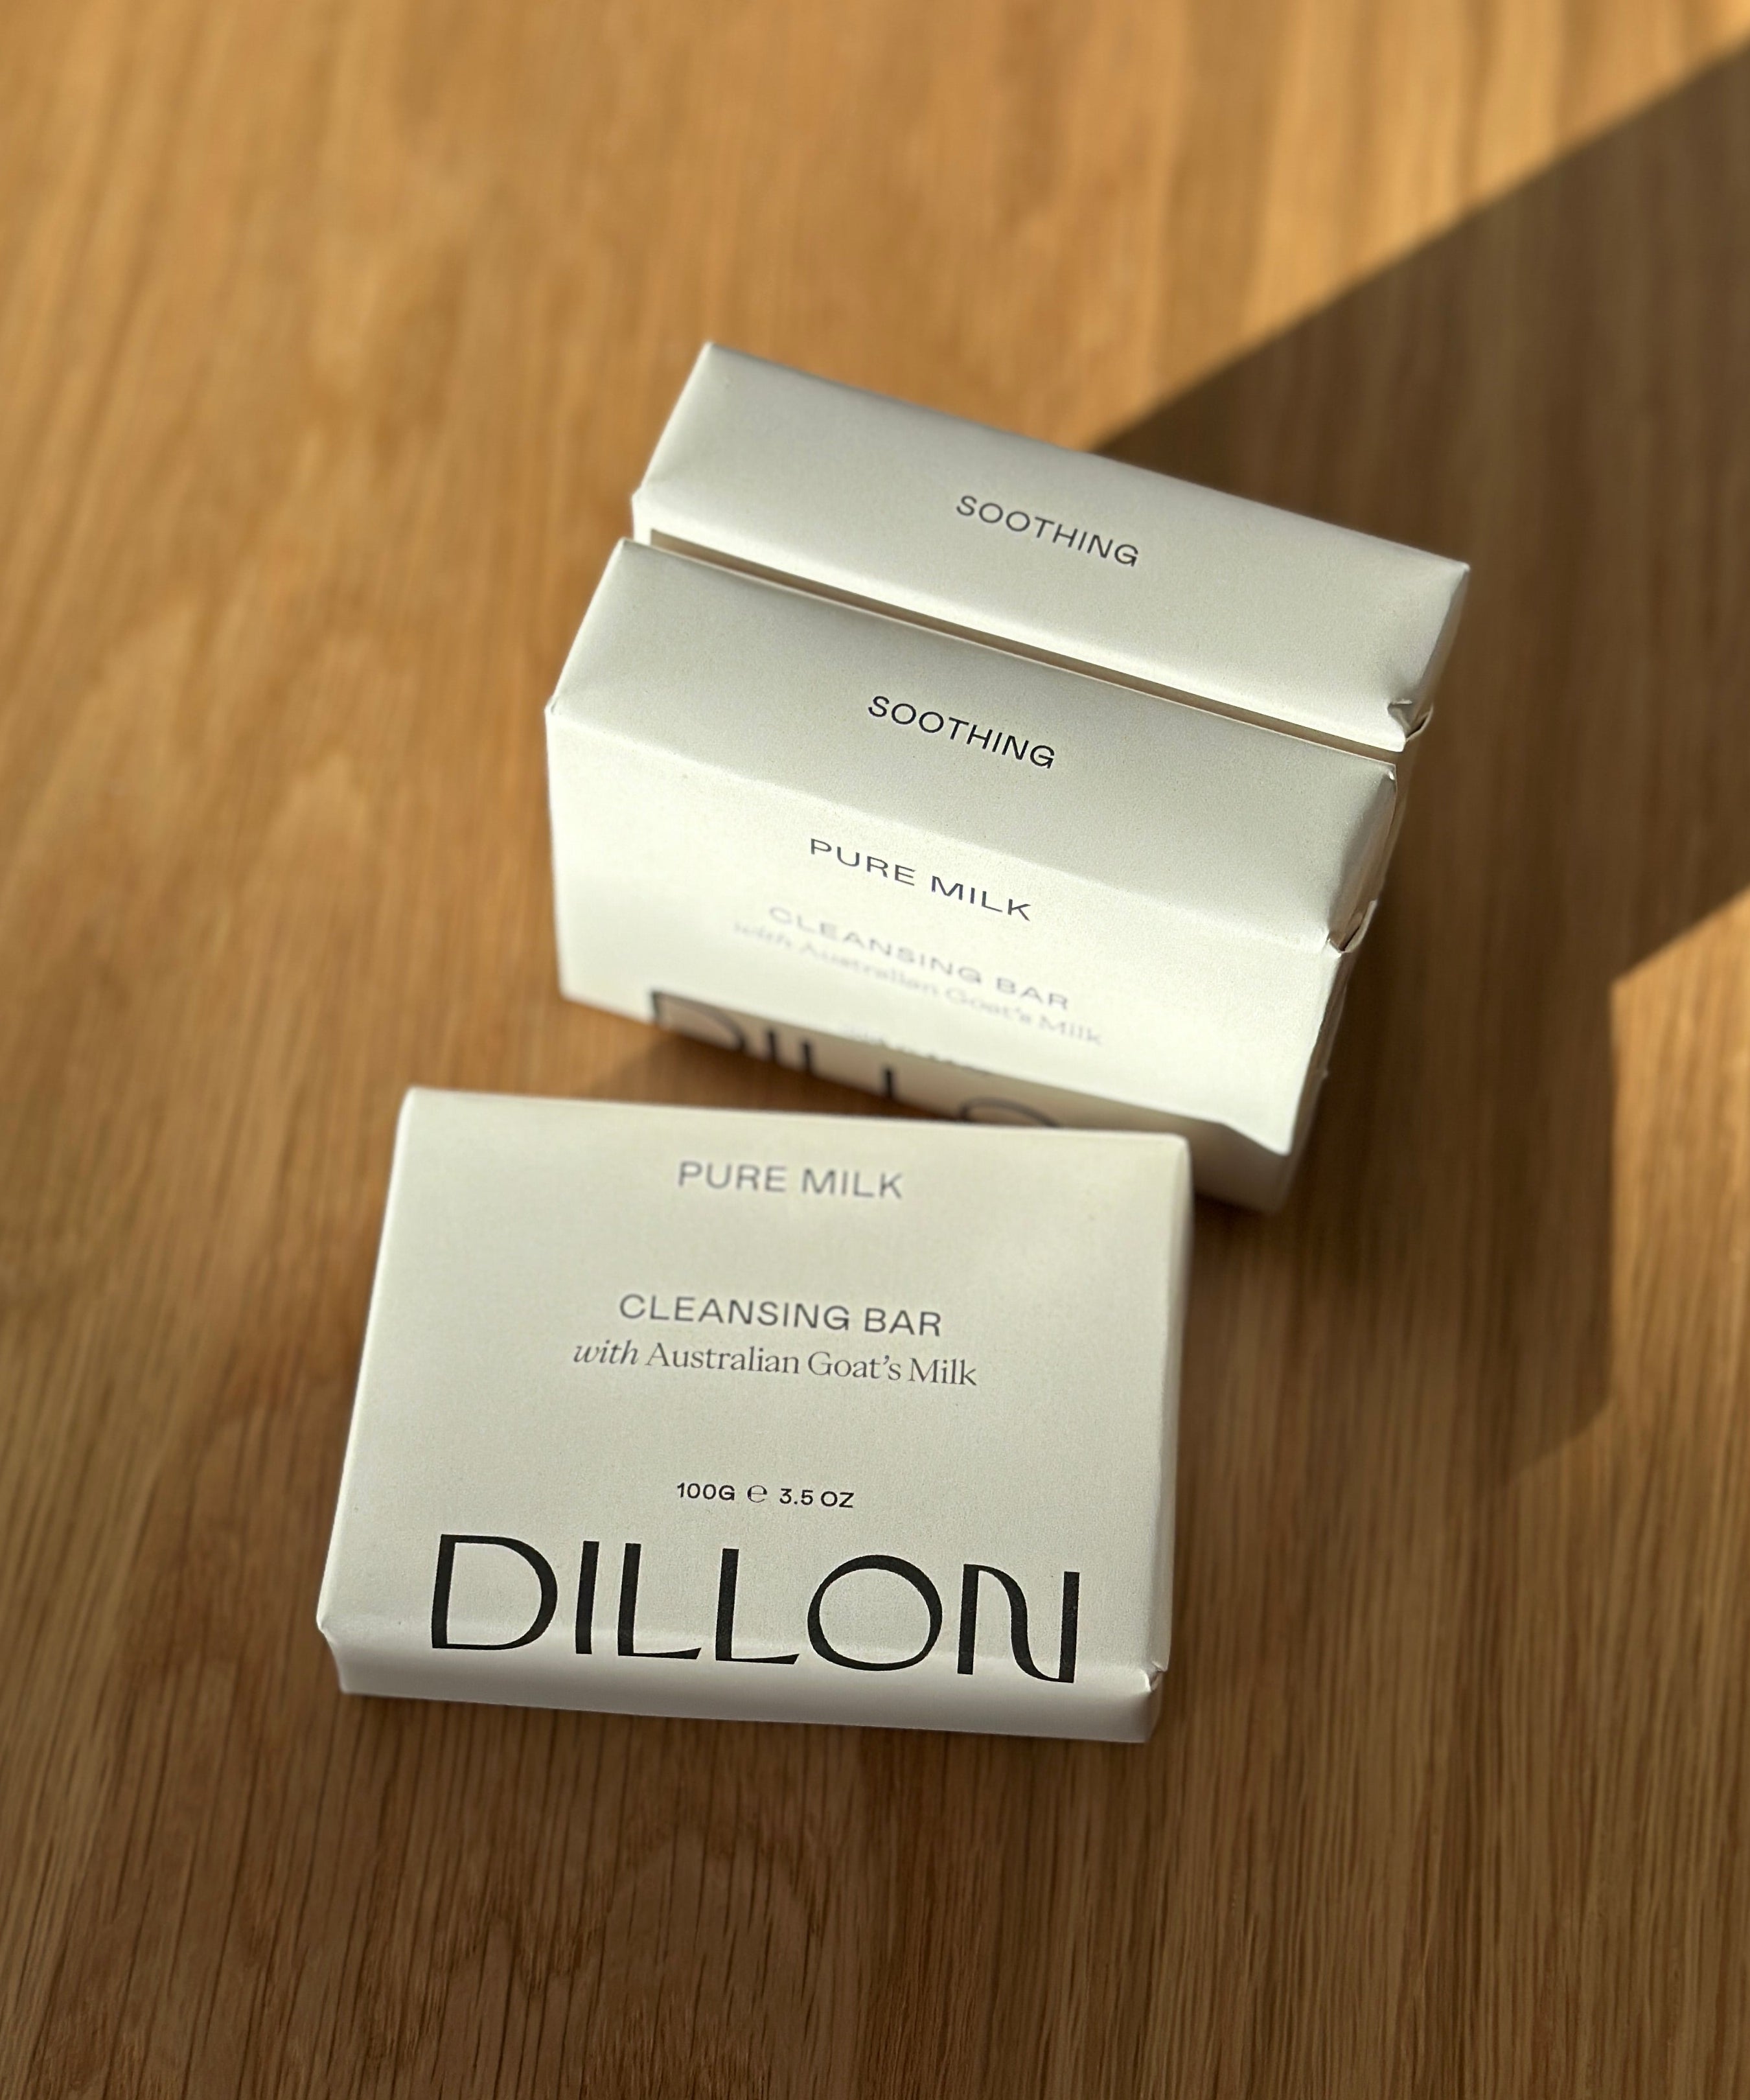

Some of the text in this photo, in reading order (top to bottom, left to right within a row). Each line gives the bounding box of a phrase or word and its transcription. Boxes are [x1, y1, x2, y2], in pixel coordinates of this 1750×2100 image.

[955, 494, 1140, 568] SOOTHING
[867, 695, 1055, 770] SOOTHING
[810, 837, 1031, 921] PURE MILK
[768, 906, 1070, 1011] CLEANSING BAR
[1038, 1012, 1104, 1046] Milk
[677, 1159, 903, 1201] PURE MILK
[619, 1293, 943, 1337] CLEANSING BAR
[572, 1339, 639, 1366] with
[645, 1341, 800, 1375] Australian
[908, 1357, 978, 1387] Milk
[676, 1481, 736, 1502] 100G
[778, 1487, 814, 1506] 3.5
[820, 1490, 855, 1509] OZ
[430, 1533, 1081, 1684] DILLON
